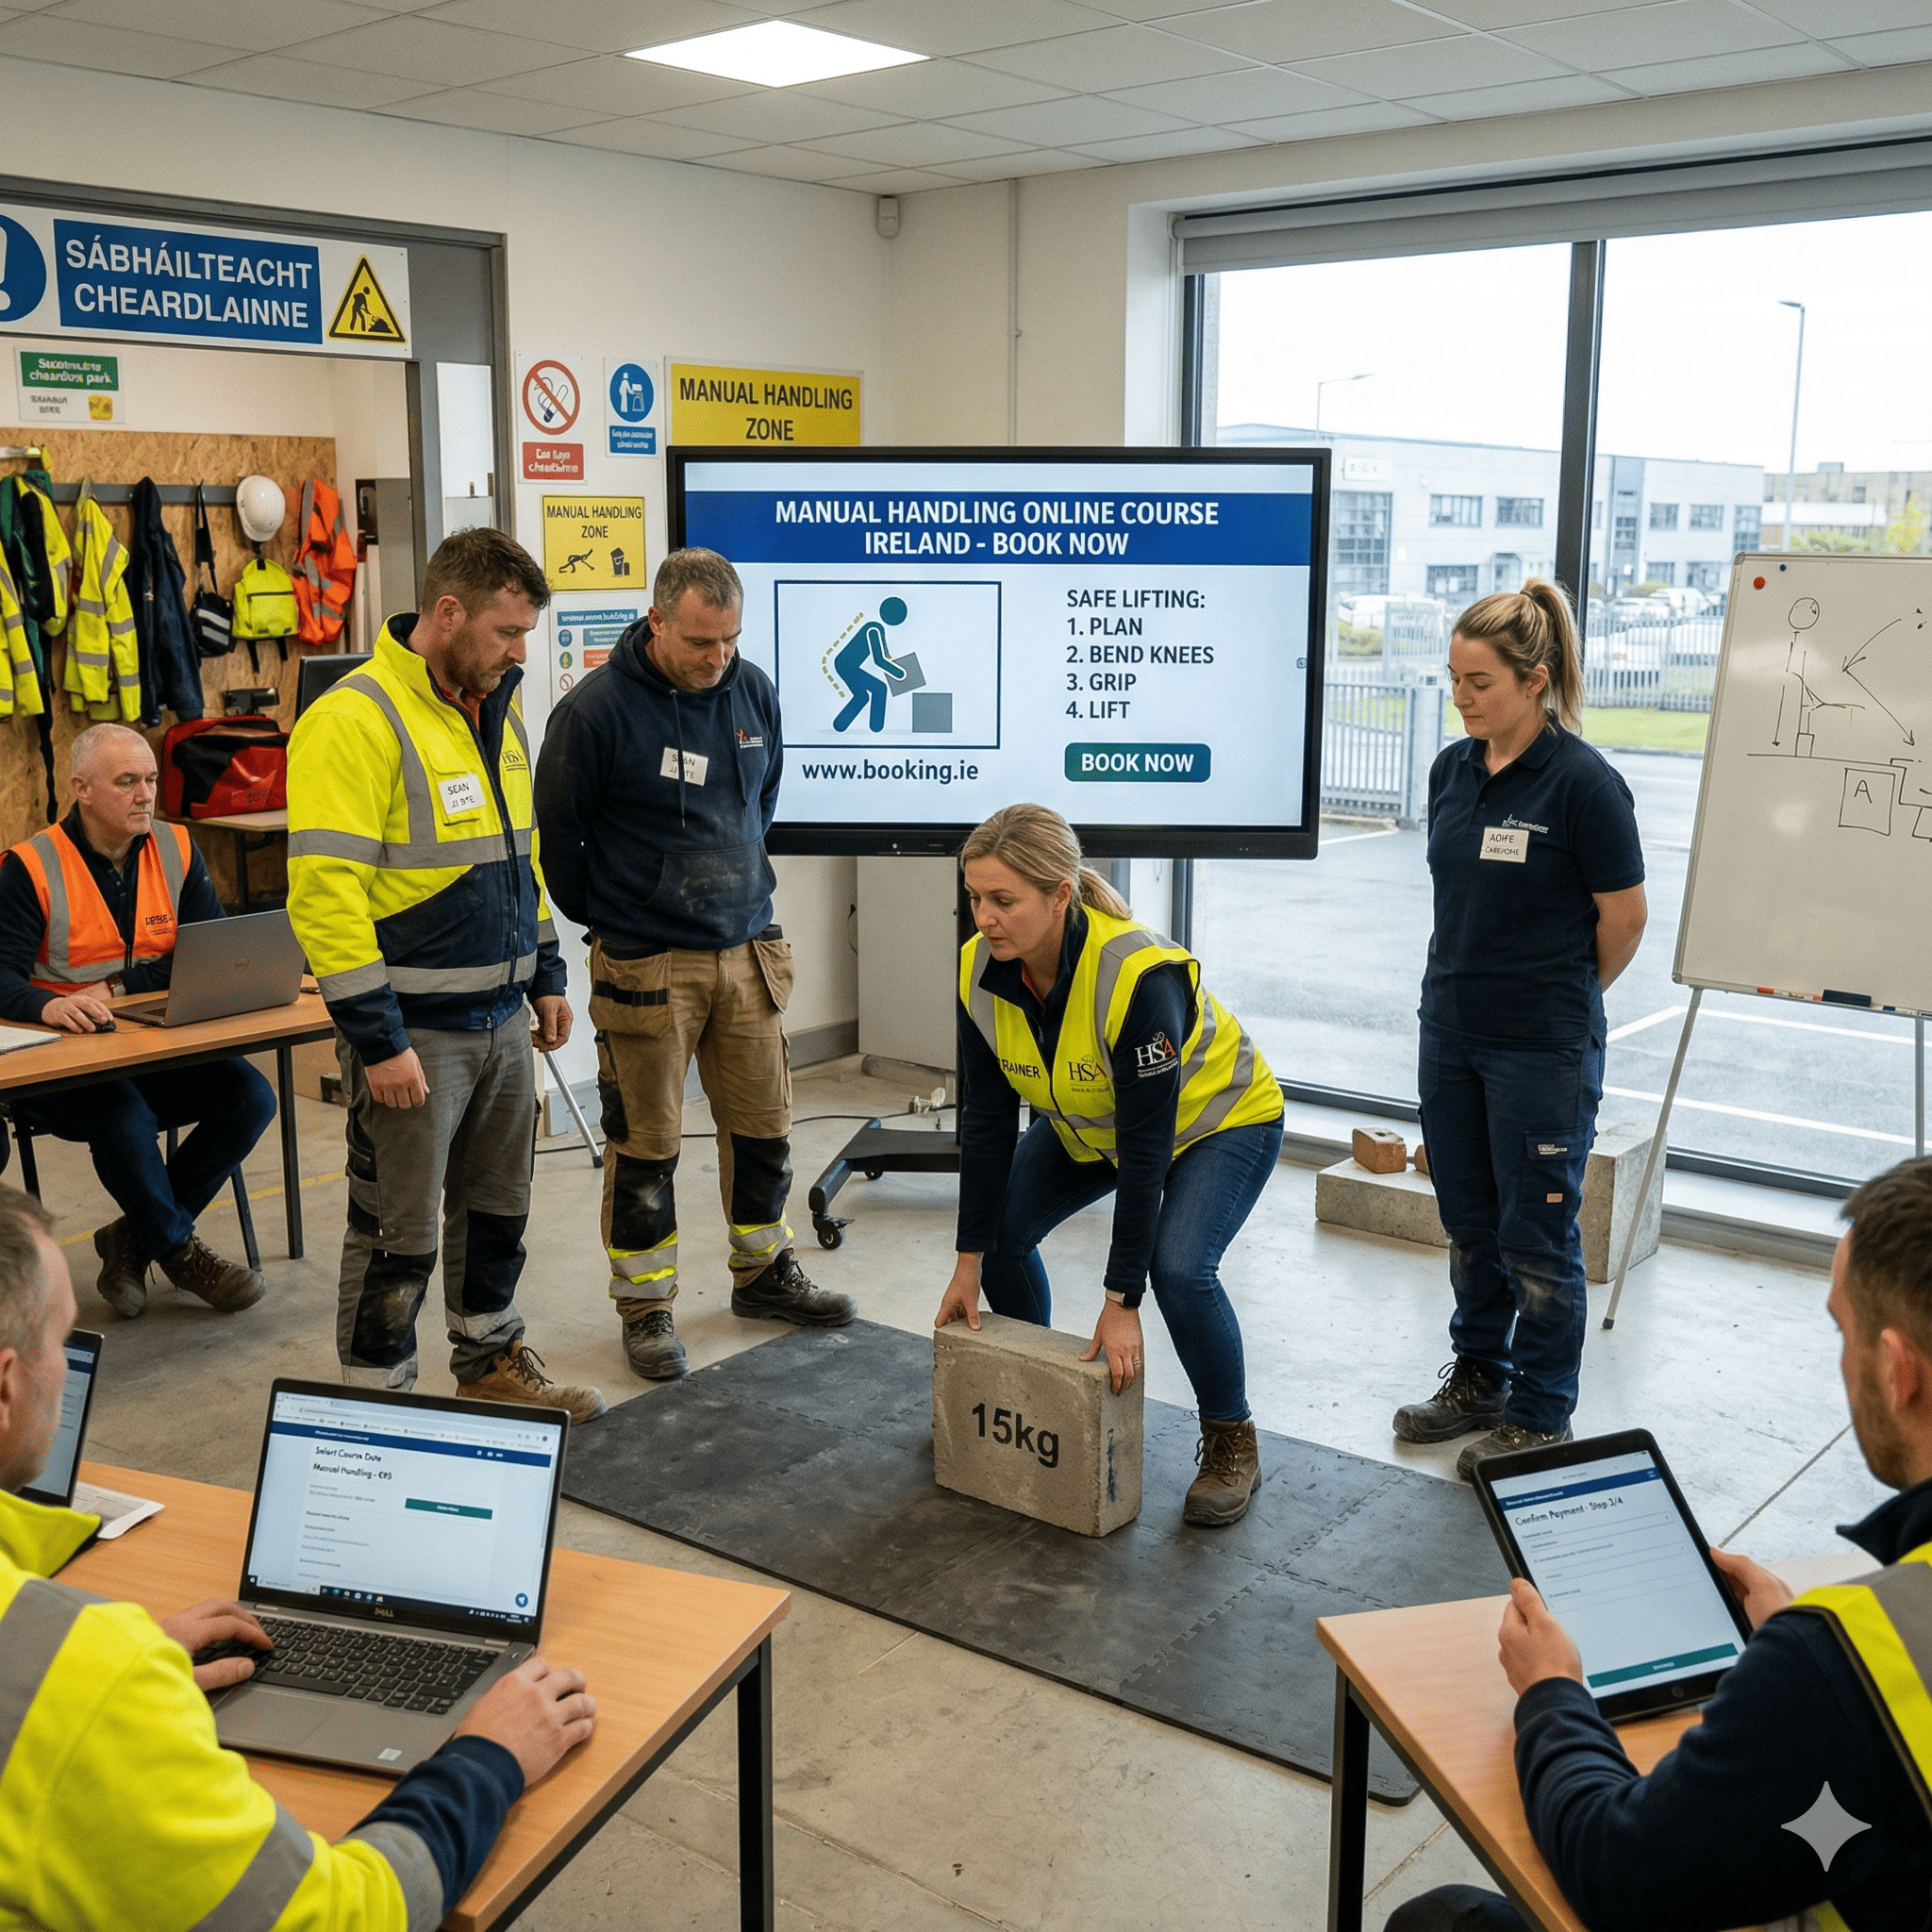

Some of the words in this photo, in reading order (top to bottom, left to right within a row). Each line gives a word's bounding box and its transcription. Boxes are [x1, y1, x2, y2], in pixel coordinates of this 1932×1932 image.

[66, 234, 312, 290] SÁBHÁILTEACHT
[75, 283, 308, 328] CHEARDLAINNE
[680, 377, 759, 405] MANUAL
[764, 382, 853, 410] HANDLING
[745, 417, 794, 441] ZONE
[547, 505, 590, 519] MANUAL
[591, 505, 641, 519] HANDLING
[775, 501, 882, 524] MANUAL
[888, 501, 1017, 525] HANDLING
[1023, 501, 1115, 525] ONLINE
[1121, 502, 1220, 525] COURSE
[581, 525, 608, 539] ZONE
[864, 532, 971, 555] IRELAND
[992, 532, 1062, 555] BOOK
[1069, 533, 1130, 555] NOW
[1067, 590, 1117, 608] SAFE
[1123, 590, 1206, 608] LIFTING:
[1067, 617, 1084, 635] 1.
[1090, 617, 1142, 636] PLAN
[1066, 645, 1084, 663] 2.
[1090, 645, 1144, 663] BEND
[1150, 645, 1215, 664] KNEES
[1066, 673, 1084, 691] 3.
[1089, 673, 1137, 691] GRIP
[1065, 700, 1084, 719] 4.
[1090, 700, 1131, 719] LIFT
[802, 758, 979, 785] www.booking.ie
[1081, 752, 1140, 772] BOOK
[1144, 753, 1194, 773] NOW
[447, 782, 470, 795] SEAN
[1854, 779, 1873, 804] A
[1134, 1038, 1176, 1067] HSA
[1067, 1061, 1108, 1082] HSA
[972, 1402, 1059, 1469] 15kg
